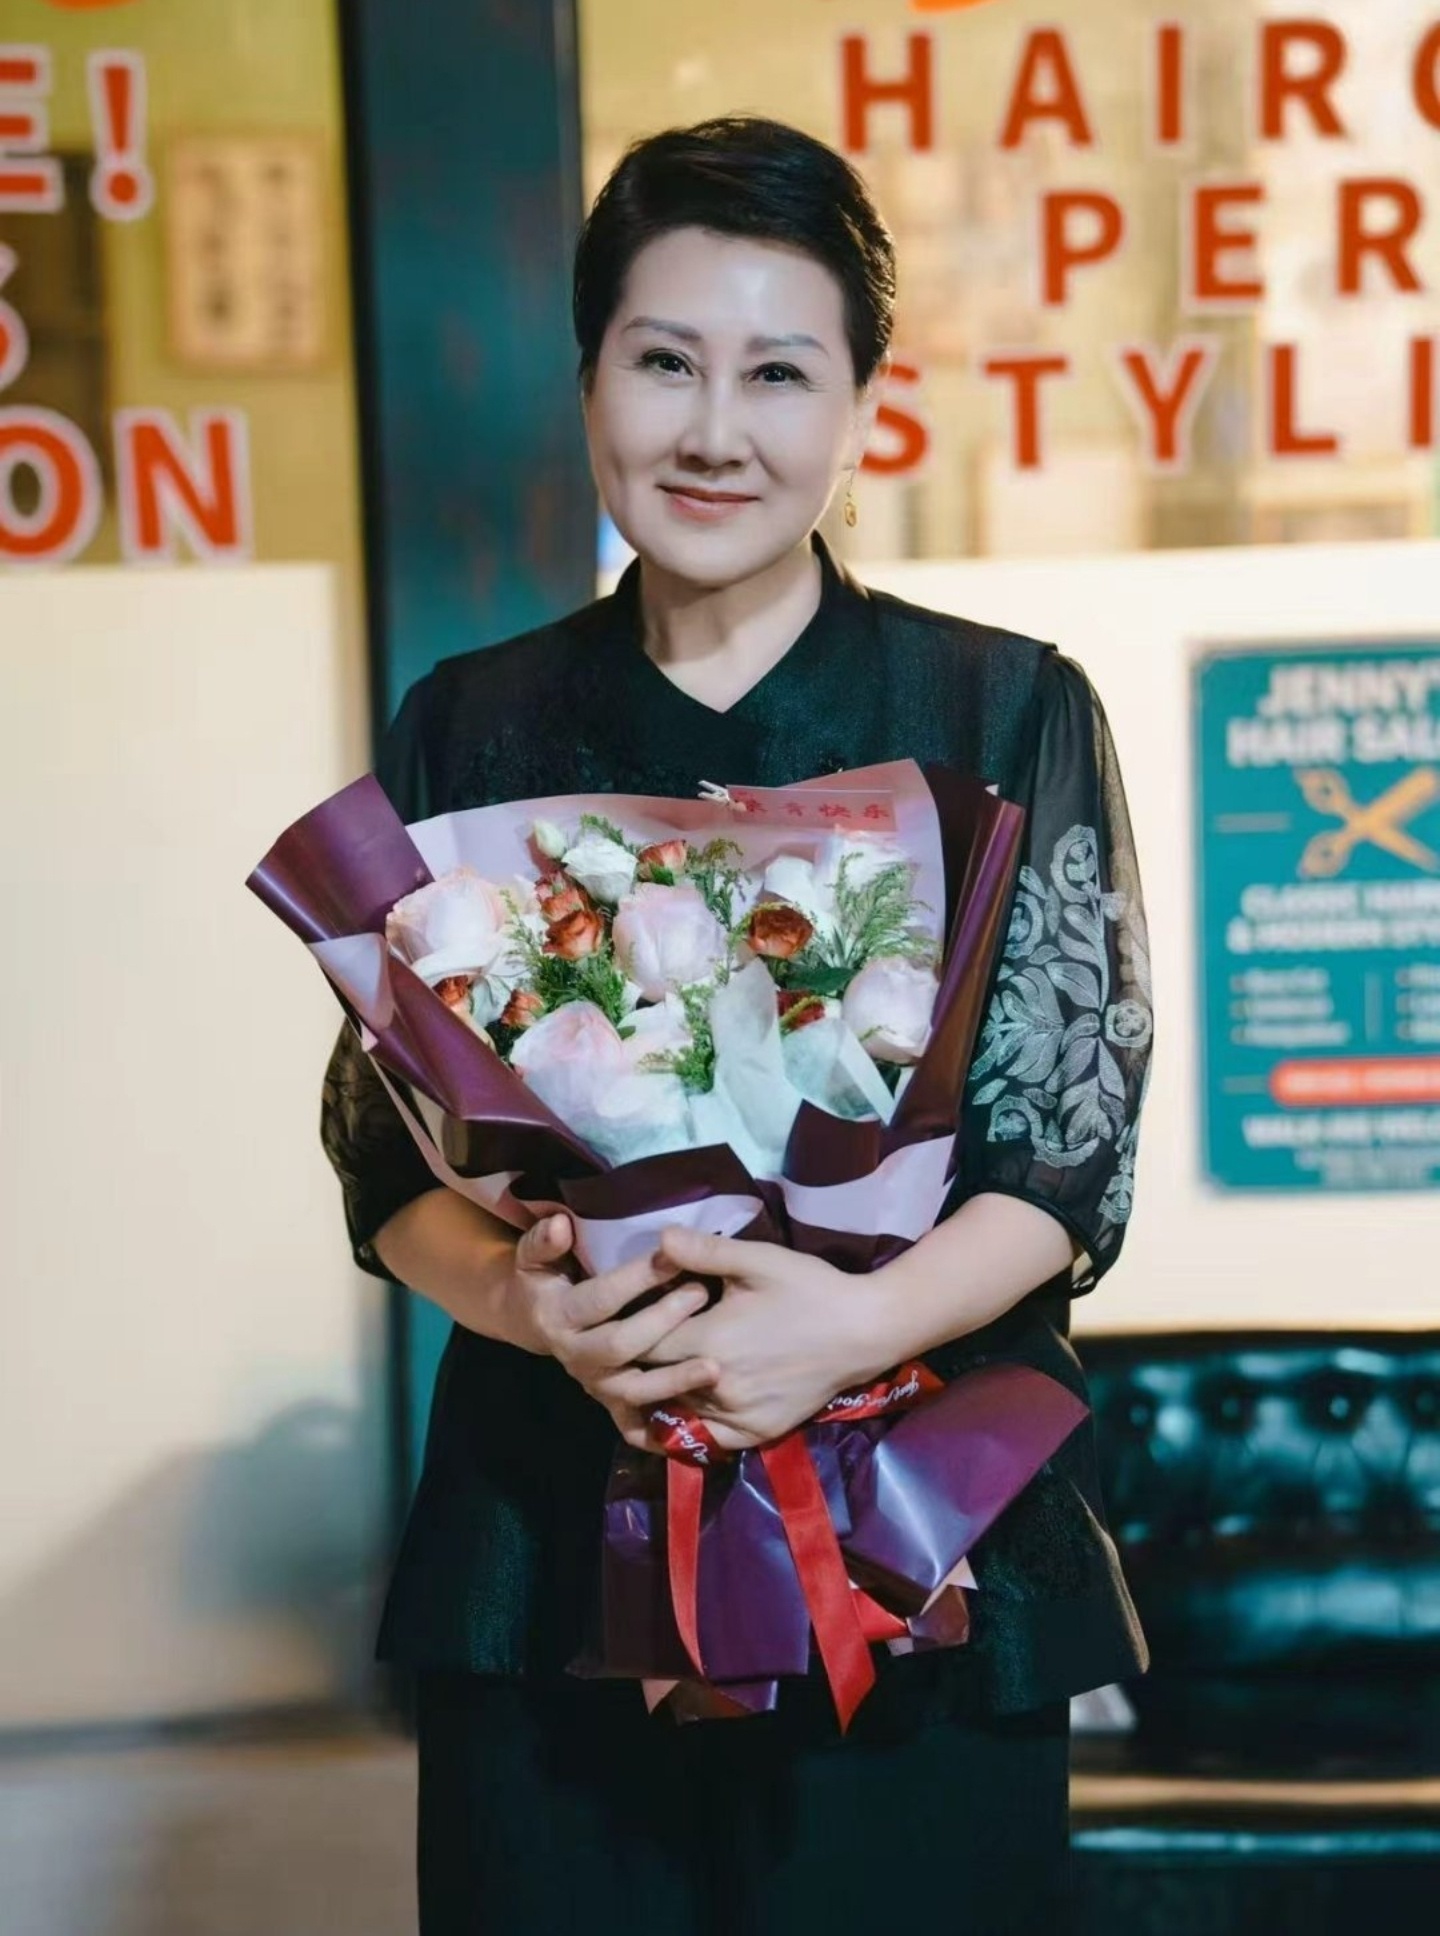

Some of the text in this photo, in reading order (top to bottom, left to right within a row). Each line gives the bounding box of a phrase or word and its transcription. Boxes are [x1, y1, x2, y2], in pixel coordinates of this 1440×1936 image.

[1041, 177, 1424, 304] PER
[859, 337, 1434, 474] STYLI
[0, 419, 239, 557] ON
[1352, 712, 1440, 762] SAL
